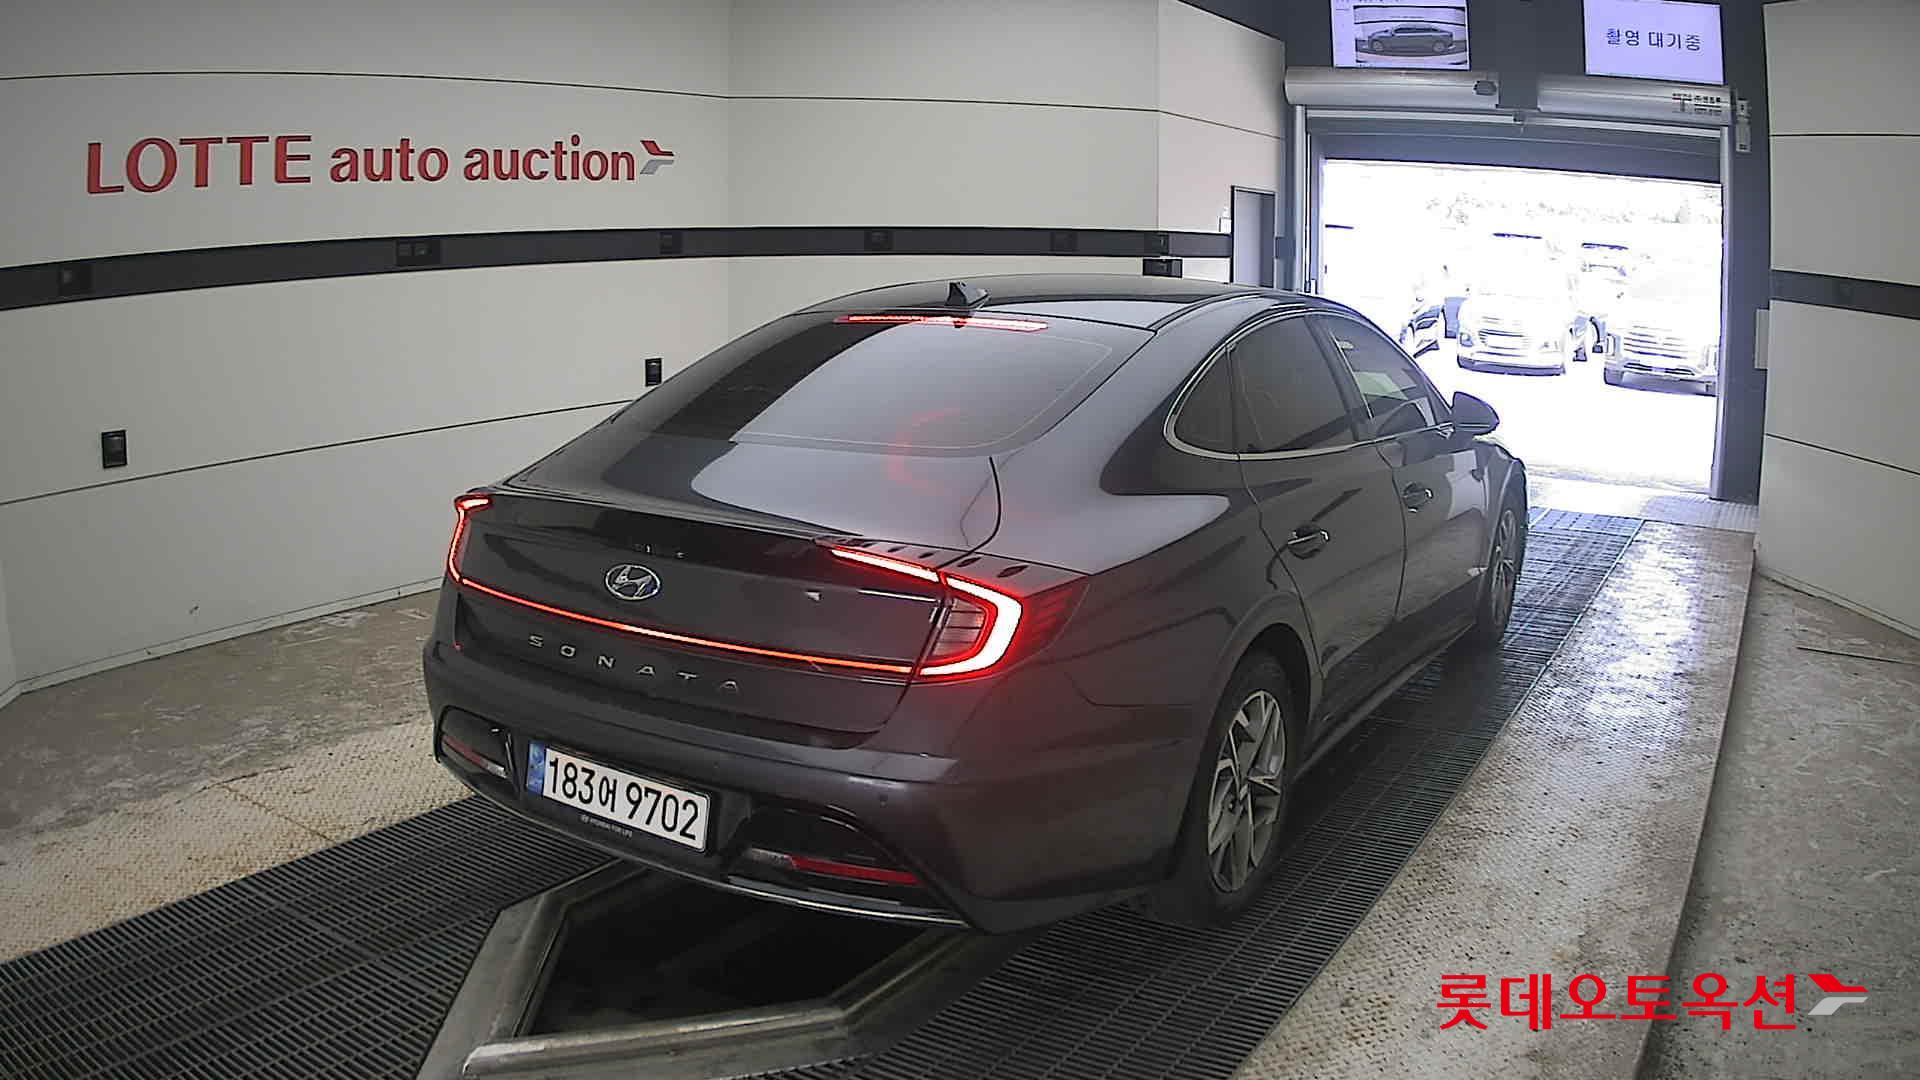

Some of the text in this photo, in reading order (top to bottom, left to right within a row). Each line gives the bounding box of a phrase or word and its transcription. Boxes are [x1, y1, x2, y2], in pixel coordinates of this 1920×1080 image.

[1648, 31, 1701, 51] 대기중
[87, 134, 636, 195] LOTTE auto auction
[528, 634, 739, 691] SONATA
[549, 757, 617, 813] 183어
[625, 781, 700, 841] 9702
